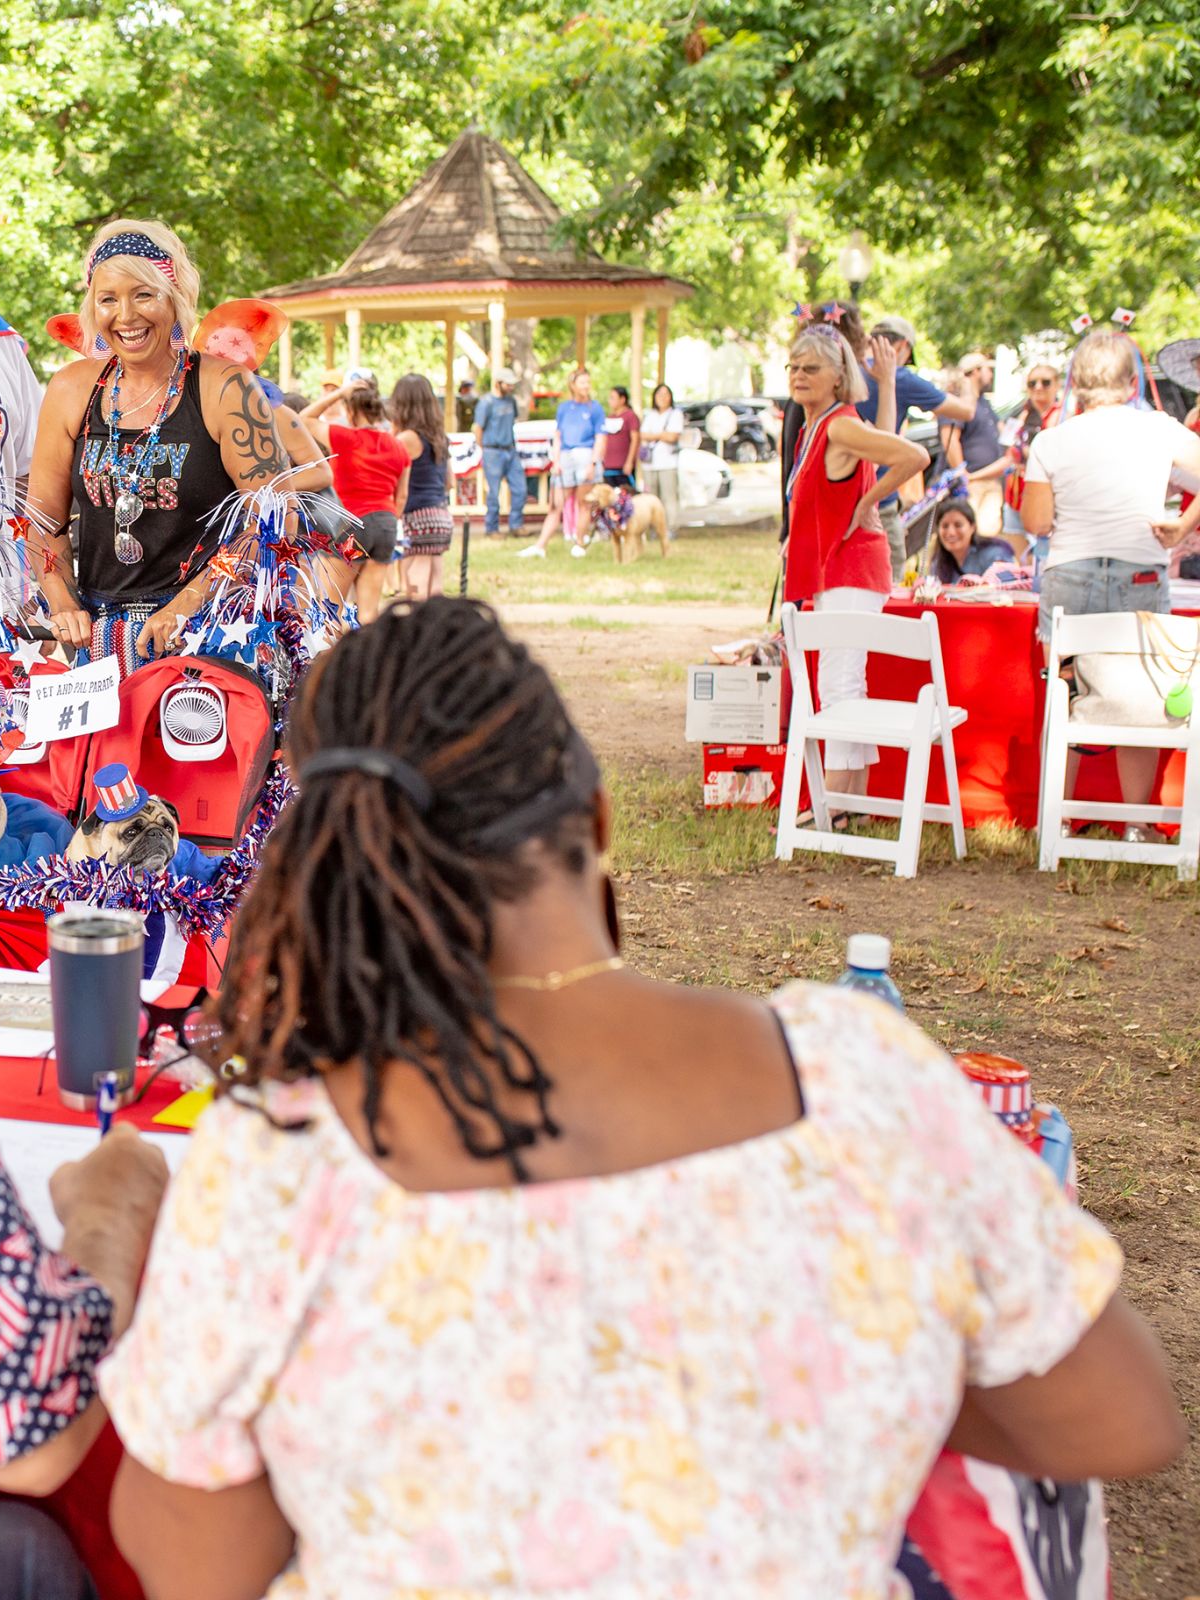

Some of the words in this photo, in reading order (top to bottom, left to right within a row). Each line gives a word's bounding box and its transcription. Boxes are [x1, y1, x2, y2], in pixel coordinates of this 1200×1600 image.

[79, 439, 191, 479] HAPPY
[36, 685, 54, 701] PET
[56, 683, 74, 696] AND
[73, 681, 88, 694] PAL
[88, 675, 115, 694] PARADE
[57, 700, 90, 732] #1
